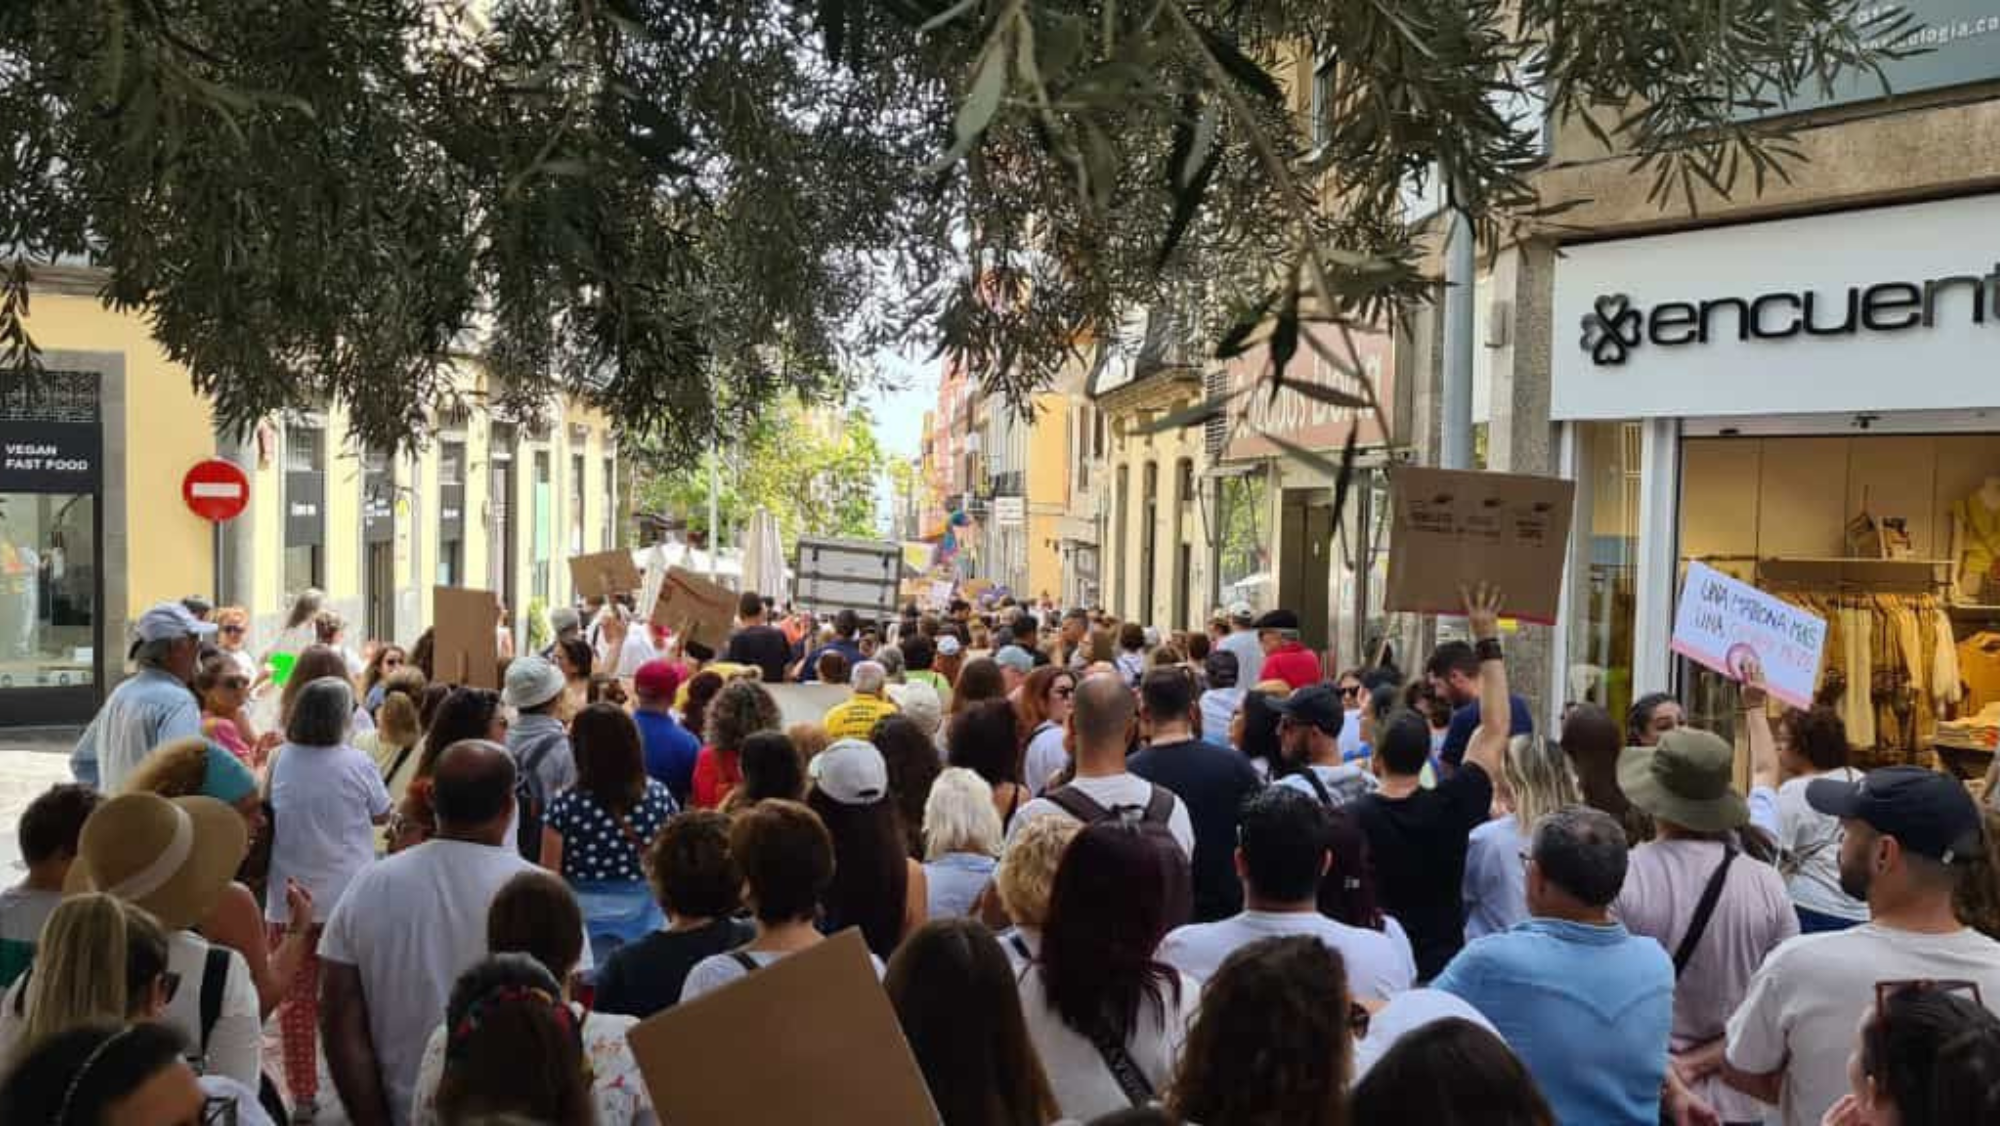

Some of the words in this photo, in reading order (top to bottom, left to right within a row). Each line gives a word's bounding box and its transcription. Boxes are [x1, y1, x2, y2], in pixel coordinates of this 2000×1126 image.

[5, 443, 57, 455] VEGAN
[5, 458, 40, 470] FAST
[45, 458, 88, 470] FOOD
